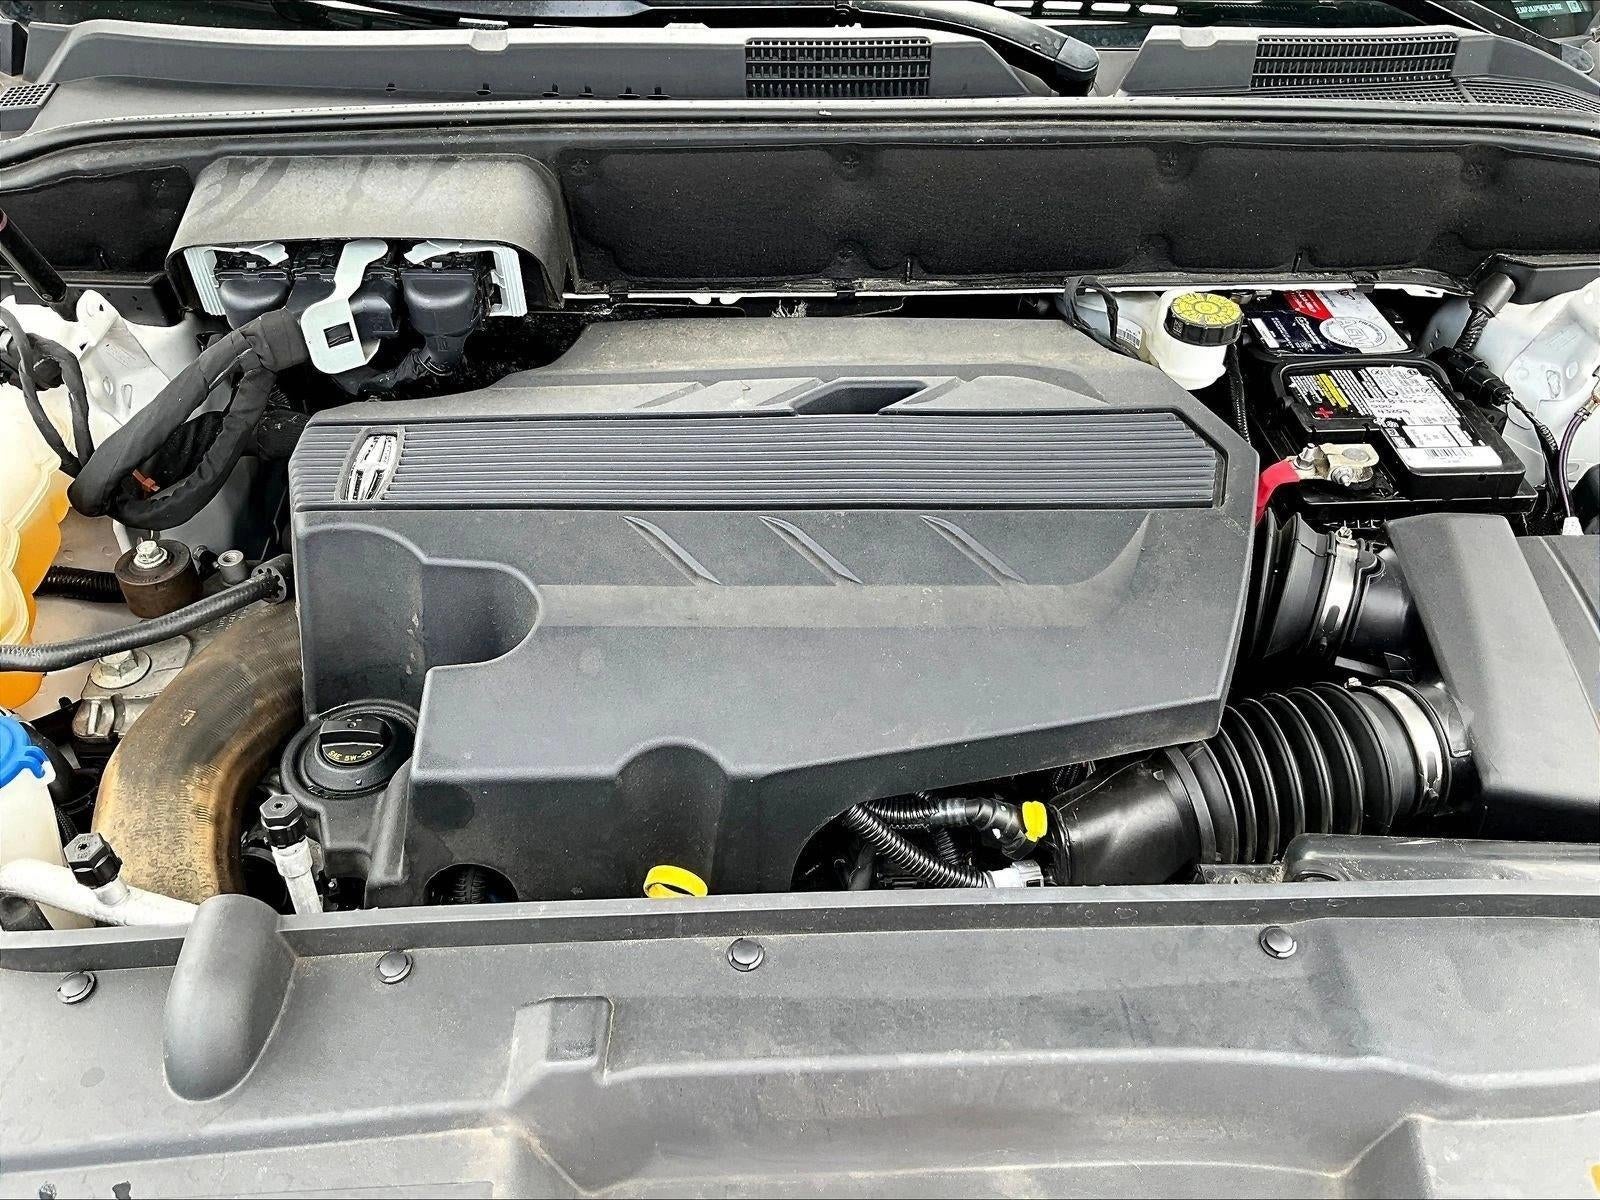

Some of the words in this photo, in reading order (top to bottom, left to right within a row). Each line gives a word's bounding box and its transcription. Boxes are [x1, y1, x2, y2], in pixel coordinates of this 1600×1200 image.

[1340, 320, 1375, 348] AGM
[328, 750, 342, 760] SAE
[345, 750, 373, 761] 5W-30
